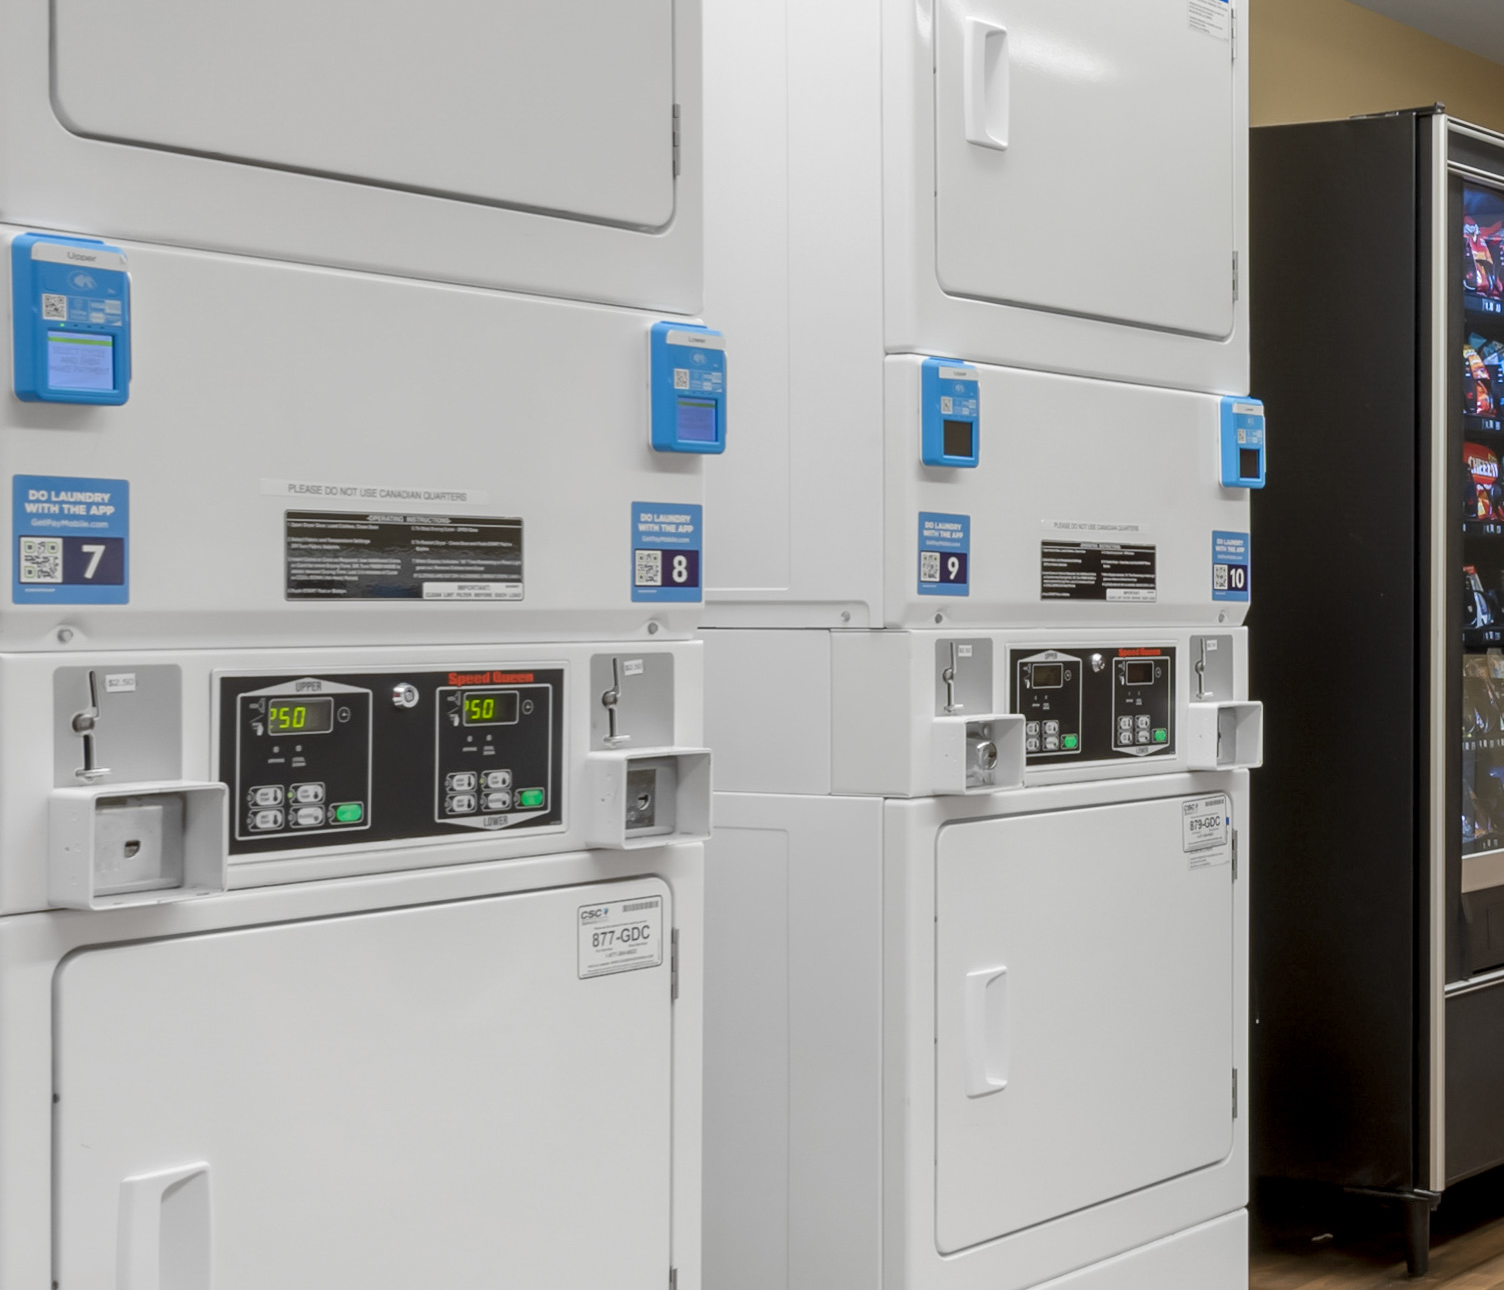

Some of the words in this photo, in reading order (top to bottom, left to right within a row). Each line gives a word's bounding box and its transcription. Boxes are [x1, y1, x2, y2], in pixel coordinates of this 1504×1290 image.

[67, 251, 96, 262] Upper
[28, 489, 48, 501] DO
[51, 491, 111, 503] LAUNDRY
[288, 484, 323, 494] PLEASE
[324, 486, 338, 495] DO
[339, 487, 358, 496] NOT
[359, 488, 378, 498] USE
[379, 489, 422, 500] CANADIAN
[423, 491, 467, 502] QUARTERS
[24, 503, 59, 514] WITH
[62, 504, 87, 515] THE
[89, 505, 115, 516] APP
[30, 518, 109, 528] GetPayMobile.com
[640, 513, 653, 522] DO
[653, 514, 691, 524] LAUNDRY
[637, 523, 660, 532] WITH
[661, 524, 677, 533] THE
[677, 525, 694, 534] APP
[81, 544, 106, 579] 7
[947, 556, 959, 580] 9
[672, 554, 688, 583] 8
[1230, 568, 1244, 589] 10
[108, 678, 134, 687] $2.50
[448, 672, 491, 687] Speed
[492, 671, 534, 683] Queen
[296, 681, 322, 692] UPPER
[483, 815, 508, 827] LOWER
[580, 908, 602, 920] CSC
[592, 925, 650, 948] 877-GDC
